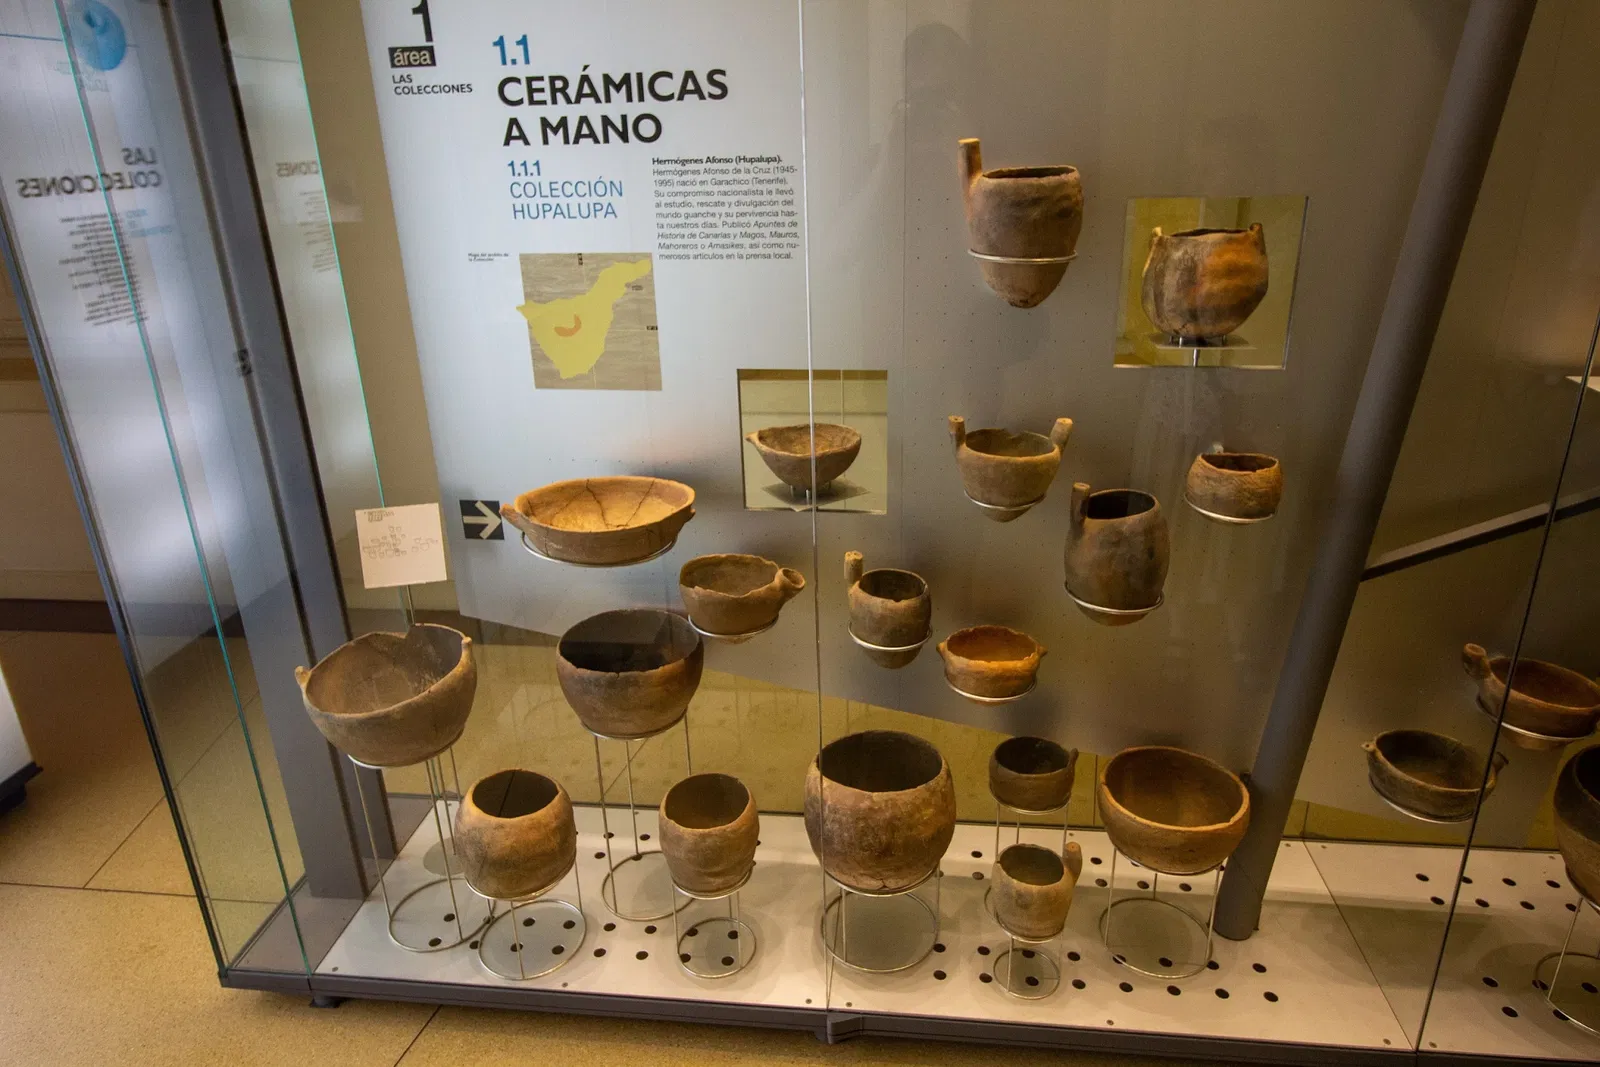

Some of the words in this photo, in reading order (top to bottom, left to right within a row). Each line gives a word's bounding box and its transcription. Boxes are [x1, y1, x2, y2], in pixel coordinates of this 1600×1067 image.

[412, 0, 433, 42] 1
[492, 34, 530, 65] 1.1
[393, 49, 431, 66] área
[392, 74, 412, 84] LAS
[394, 84, 472, 95] COLECCIONES
[498, 64, 728, 106] CERÁMICAS
[503, 117, 531, 146] A
[540, 113, 662, 145] MANO
[652, 157, 703, 166] Hermógenes
[735, 155, 782, 165] (Hupalupa).
[508, 160, 541, 177] 1.1.1
[653, 168, 701, 177] Hermógenes
[703, 167, 729, 175] Afonso
[752, 166, 770, 174] Cruz
[773, 166, 798, 174] (1945-
[510, 176, 623, 198] COLECCIÓN
[654, 179, 674, 187] 1995)
[676, 178, 697, 186] nació
[667, 190, 714, 198] compromiso
[734, 200, 779, 208] divulgación
[512, 202, 618, 220] HUPALUPA
[684, 211, 716, 220] guanche
[736, 210, 779, 219] pervivencia
[740, 231, 766, 239] Magos,
[769, 231, 799, 239] Mauros,
[692, 252, 724, 260] artículos
